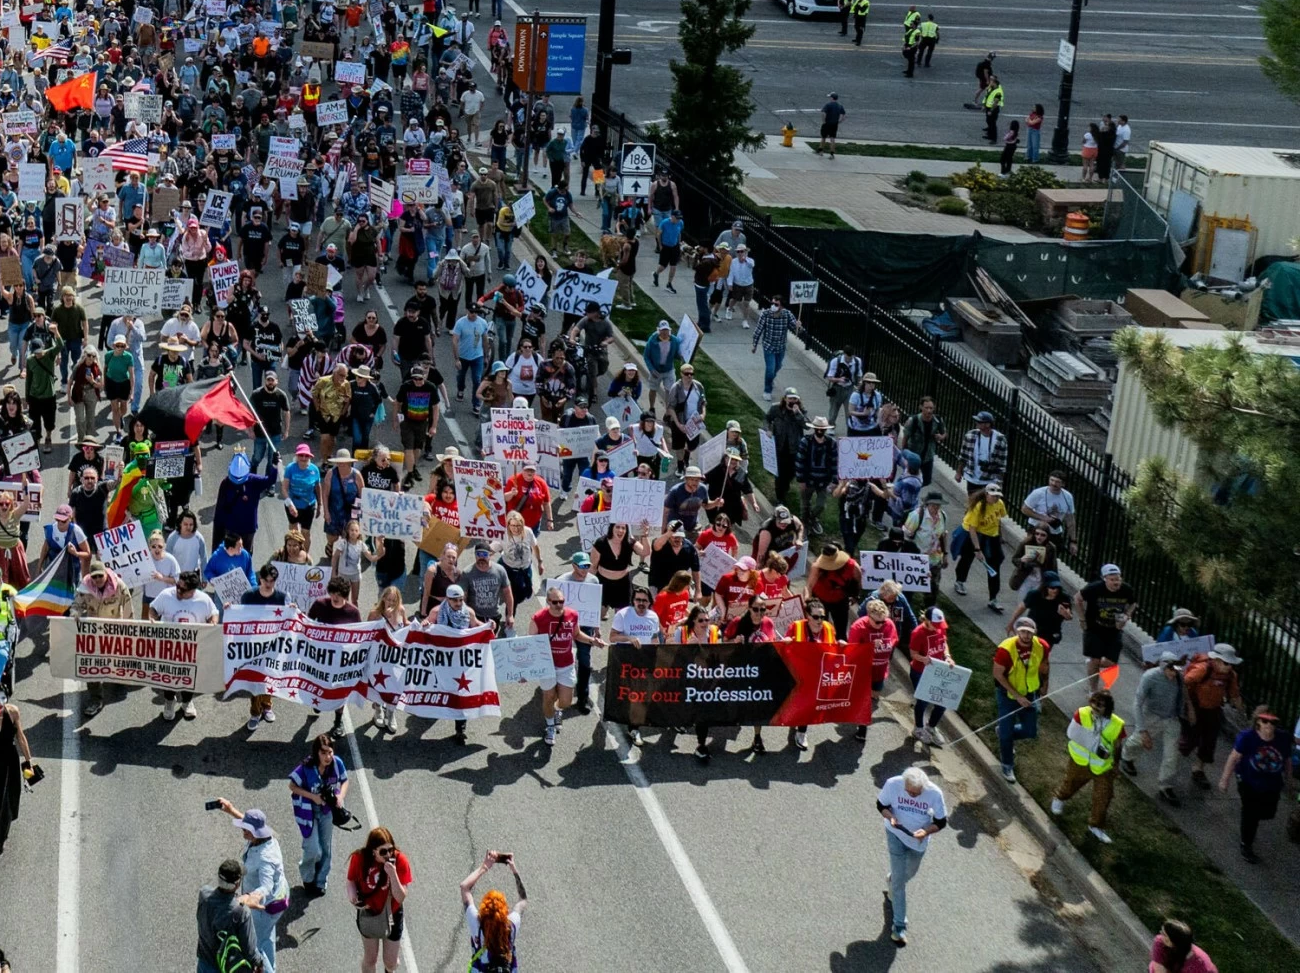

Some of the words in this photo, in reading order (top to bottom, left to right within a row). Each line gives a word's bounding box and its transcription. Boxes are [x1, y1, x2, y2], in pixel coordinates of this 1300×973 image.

[518, 29, 527, 72] DOWNTOWN
[325, 102, 339, 112] AM
[630, 153, 647, 166] 186
[268, 167, 299, 178] TRUMP
[211, 194, 227, 210] ICE
[212, 264, 238, 279] PUNKS
[518, 265, 536, 289] NO
[215, 276, 237, 290] HATE
[119, 285, 148, 297] NOT
[291, 299, 310, 309] STOP
[493, 419, 534, 431] SCHOOLS
[502, 450, 529, 460] WAR
[454, 467, 475, 476] TRUMP
[476, 469, 483, 477] IS
[484, 470, 499, 479] NOT
[478, 462, 497, 471] KING
[634, 479, 662, 493] LIKE
[367, 493, 387, 510] WE
[395, 496, 418, 511] ARE
[618, 494, 631, 504] MY
[634, 494, 657, 507] ICE
[382, 509, 400, 520] THE
[448, 510, 459, 519] MY
[369, 519, 414, 536] PEOPLE
[465, 526, 486, 537] ICE
[486, 529, 506, 540] OUT
[95, 523, 136, 550] TRUMP
[110, 546, 121, 558] IS
[872, 554, 926, 574] Billions
[283, 564, 298, 581] ARE
[892, 572, 928, 587] LOVE
[76, 622, 97, 634] VETS
[103, 623, 138, 637] SERVICE
[139, 626, 180, 640] MEMBERS
[182, 629, 198, 642] SAY
[226, 624, 242, 634] FOR
[242, 623, 256, 633] THE
[256, 622, 283, 633] FUTURE
[306, 628, 334, 640] PEOPLE
[334, 632, 351, 642] AND
[75, 634, 96, 654] NO
[99, 636, 133, 656] WAR
[136, 638, 156, 658] ON
[159, 640, 198, 663] IRAN!
[227, 637, 294, 660] STUDENTS
[296, 640, 336, 666] FIGHT
[459, 649, 483, 669] ICE
[80, 658, 93, 666] GET
[94, 658, 112, 667] HELP
[114, 659, 142, 669] LEAVING
[144, 662, 157, 671] THE
[159, 664, 192, 676] MILITARY
[265, 657, 280, 671] THE
[282, 661, 330, 682] BILLIONAIRE
[620, 663, 648, 679] For
[653, 666, 683, 679] our
[686, 663, 759, 679] Students
[78, 666, 192, 686] 800-379-2679
[822, 672, 852, 683] SLEA
[307, 684, 317, 694] OF
[317, 687, 324, 697] U
[617, 686, 647, 704] For
[651, 690, 681, 703] our
[685, 685, 774, 703] Profession
[897, 796, 929, 810] UNPAID
